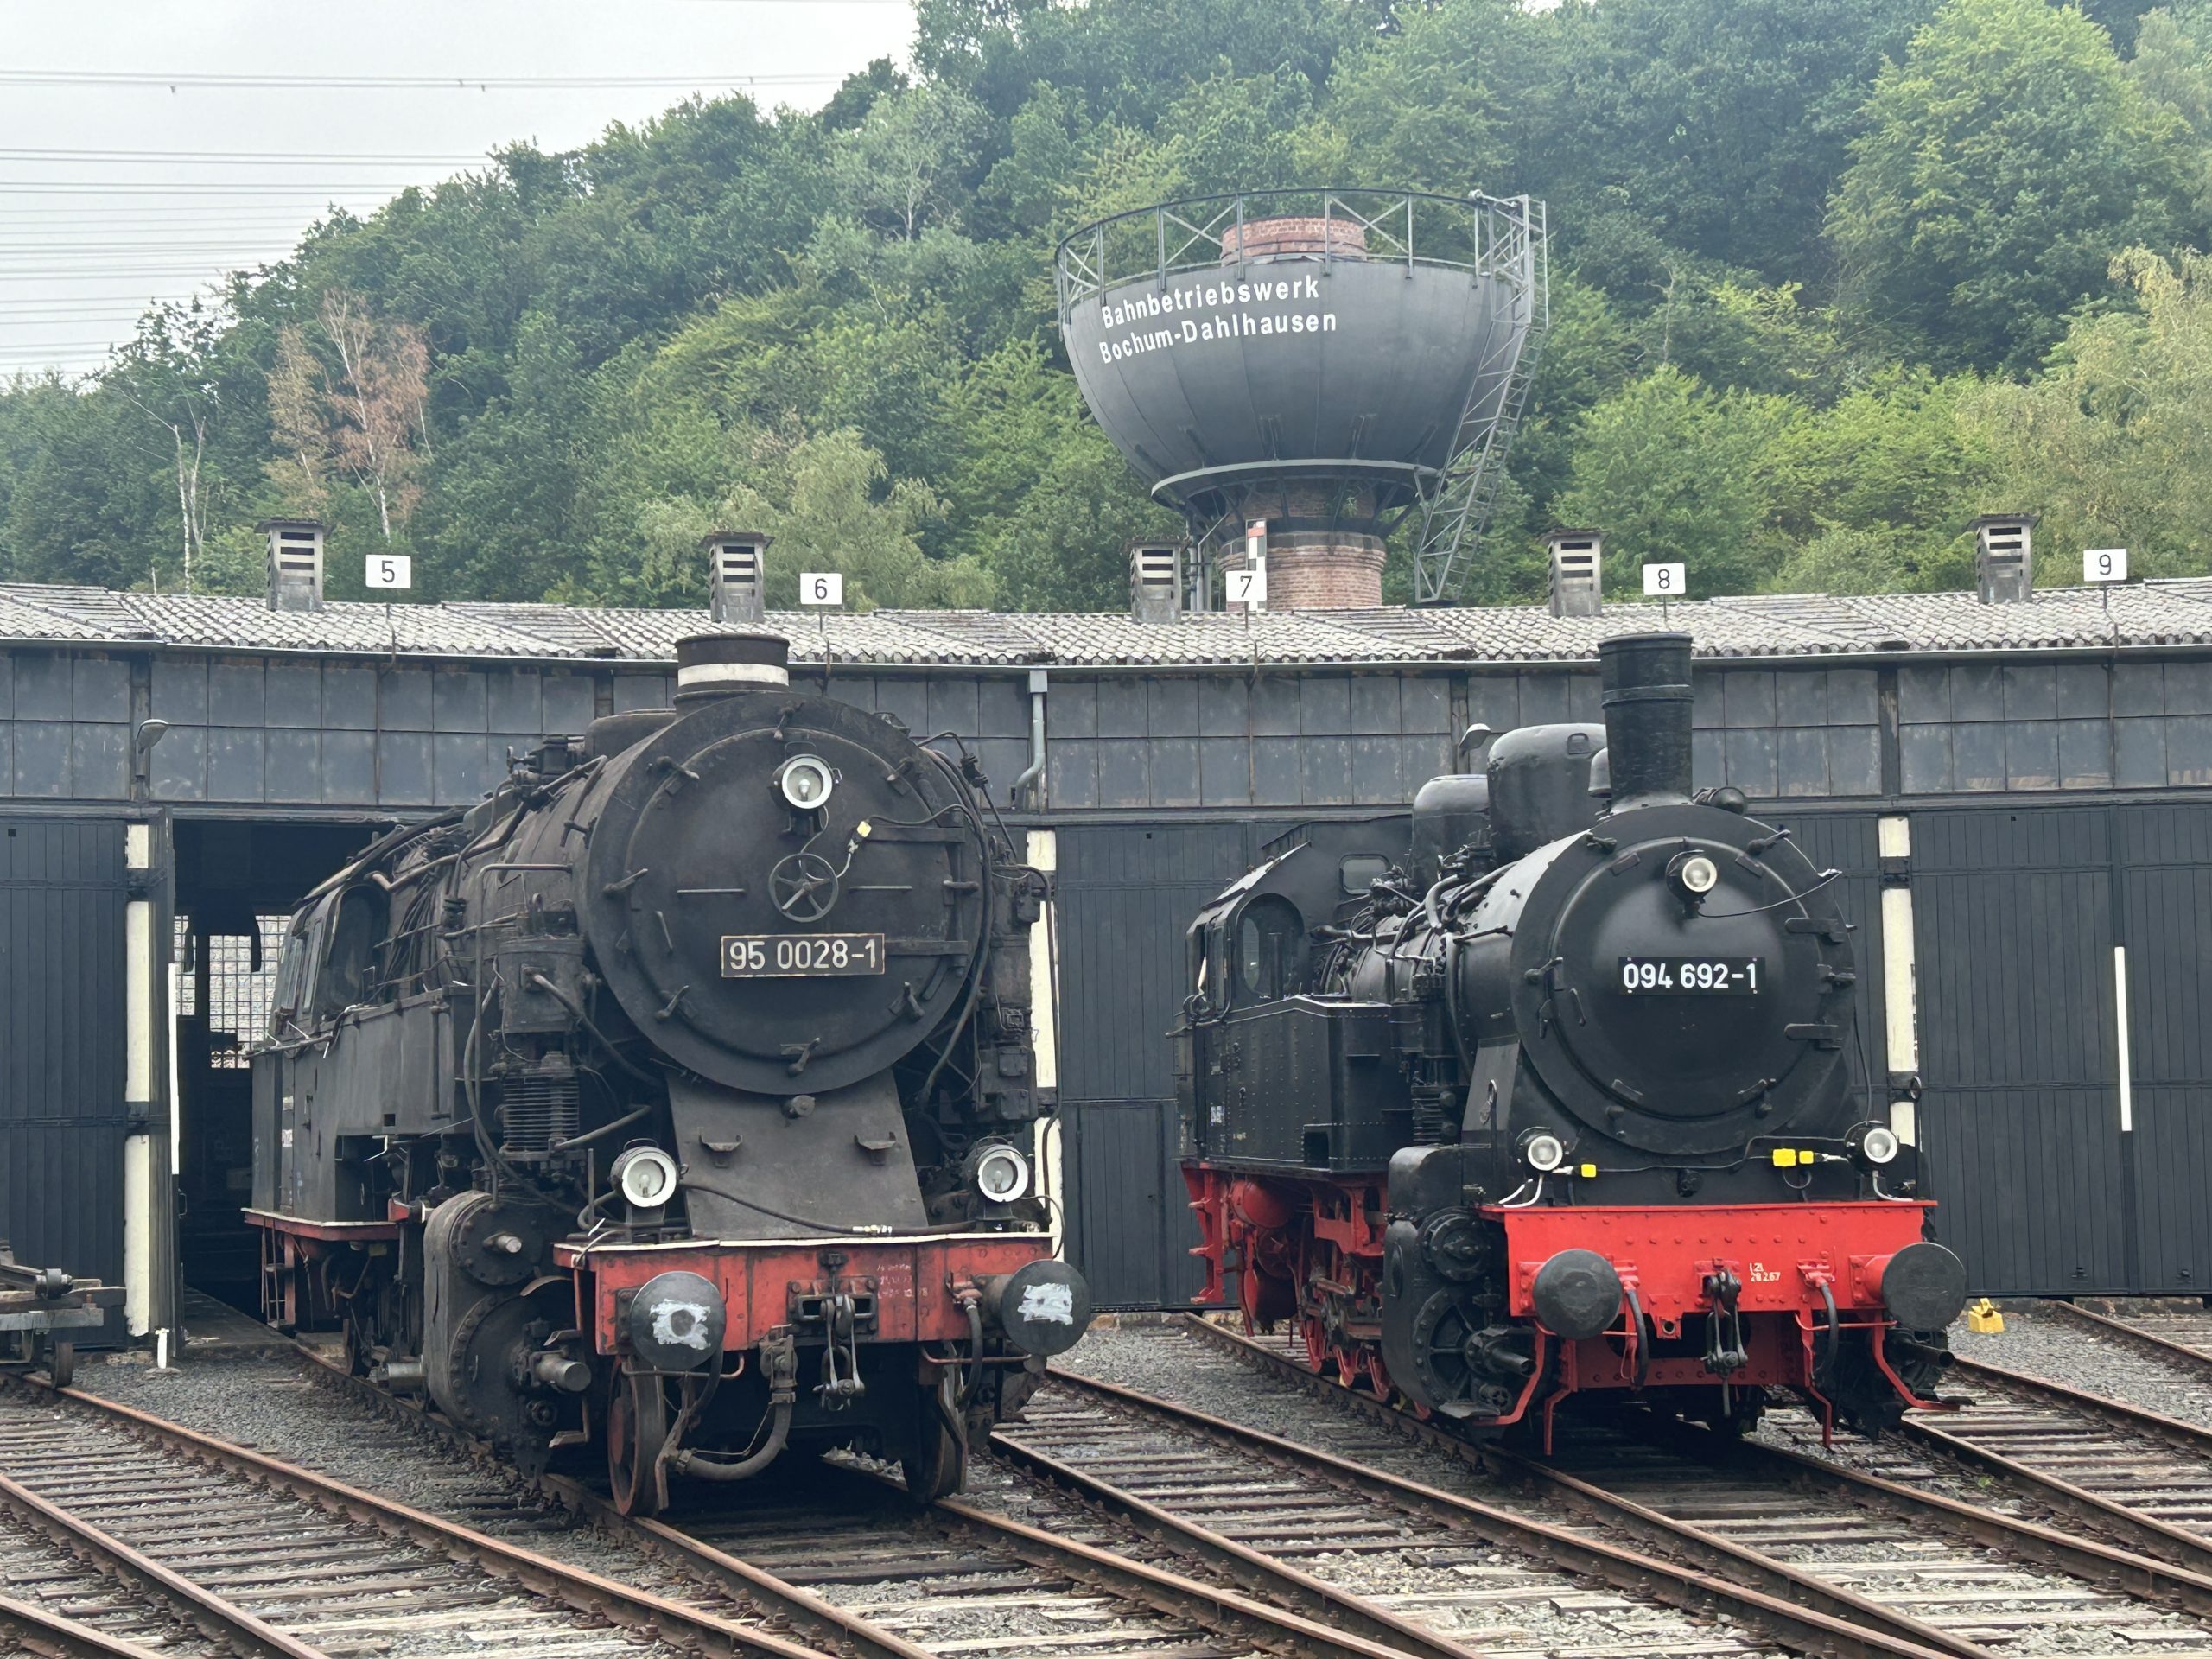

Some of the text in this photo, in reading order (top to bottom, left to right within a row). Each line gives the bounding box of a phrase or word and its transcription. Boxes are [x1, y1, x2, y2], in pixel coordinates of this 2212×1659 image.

[1102, 275, 1319, 329] Bahnbetriebswerk
[1099, 313, 1337, 365] Bochum-Dahlhausen
[381, 560, 395, 583] 5
[2099, 554, 2112, 575] 9
[815, 577, 828, 600] 6
[1240, 575, 1253, 598] 7
[1658, 569, 1670, 589] 8
[729, 938, 876, 970] 95 0028-1
[1623, 963, 1757, 989] 094 692-1
